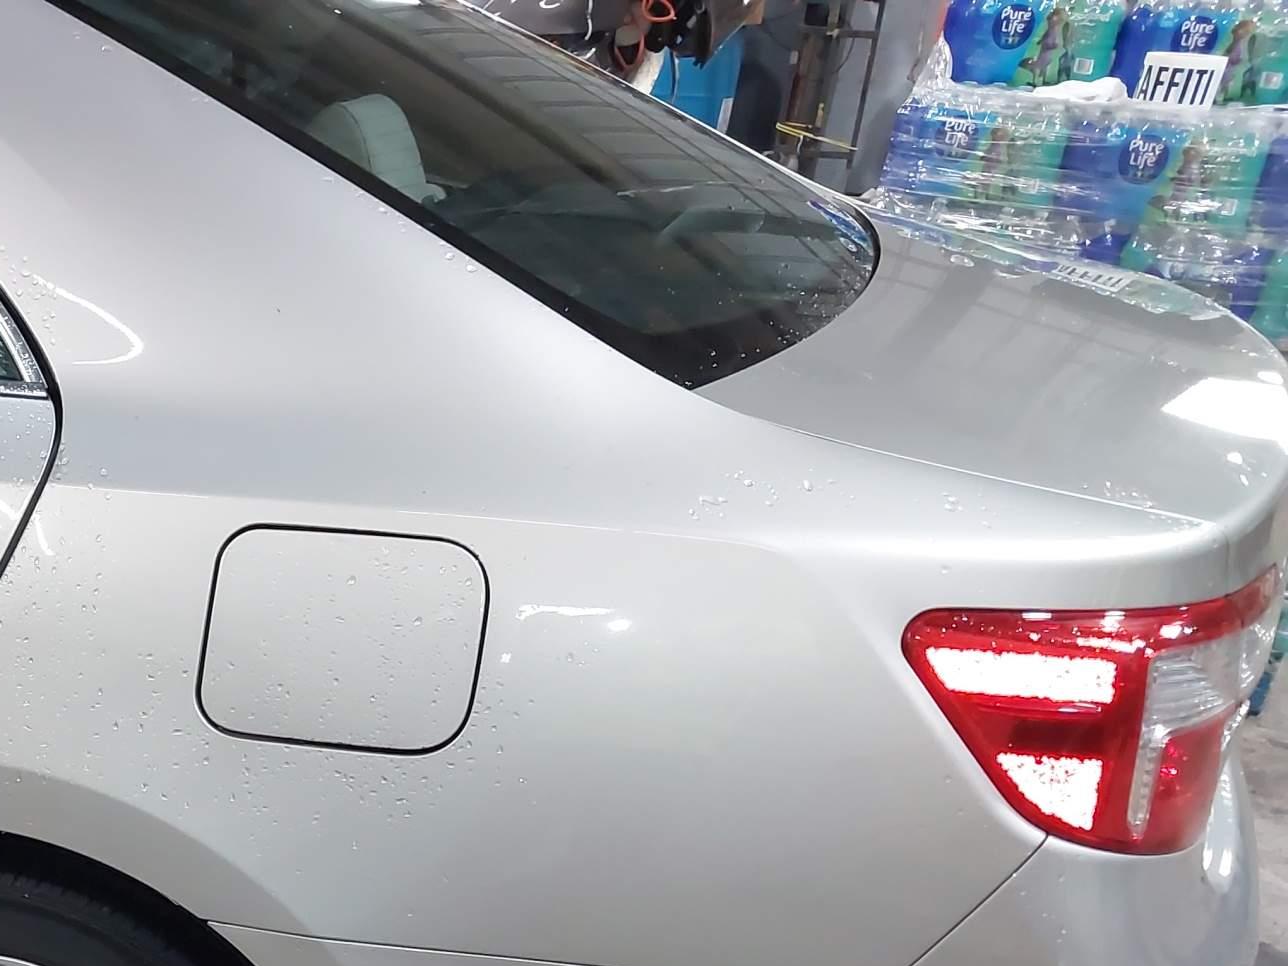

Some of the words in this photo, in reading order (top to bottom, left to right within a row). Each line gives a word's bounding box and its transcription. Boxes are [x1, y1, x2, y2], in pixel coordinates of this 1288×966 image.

[1001, 7, 1032, 21] Pure
[1001, 20, 1026, 35] Life
[1181, 20, 1215, 34] Pure
[1180, 34, 1208, 50] Life
[944, 120, 976, 134] Pure
[944, 132, 969, 148] Life
[1129, 138, 1165, 154] Pure
[1129, 152, 1157, 169] Life
